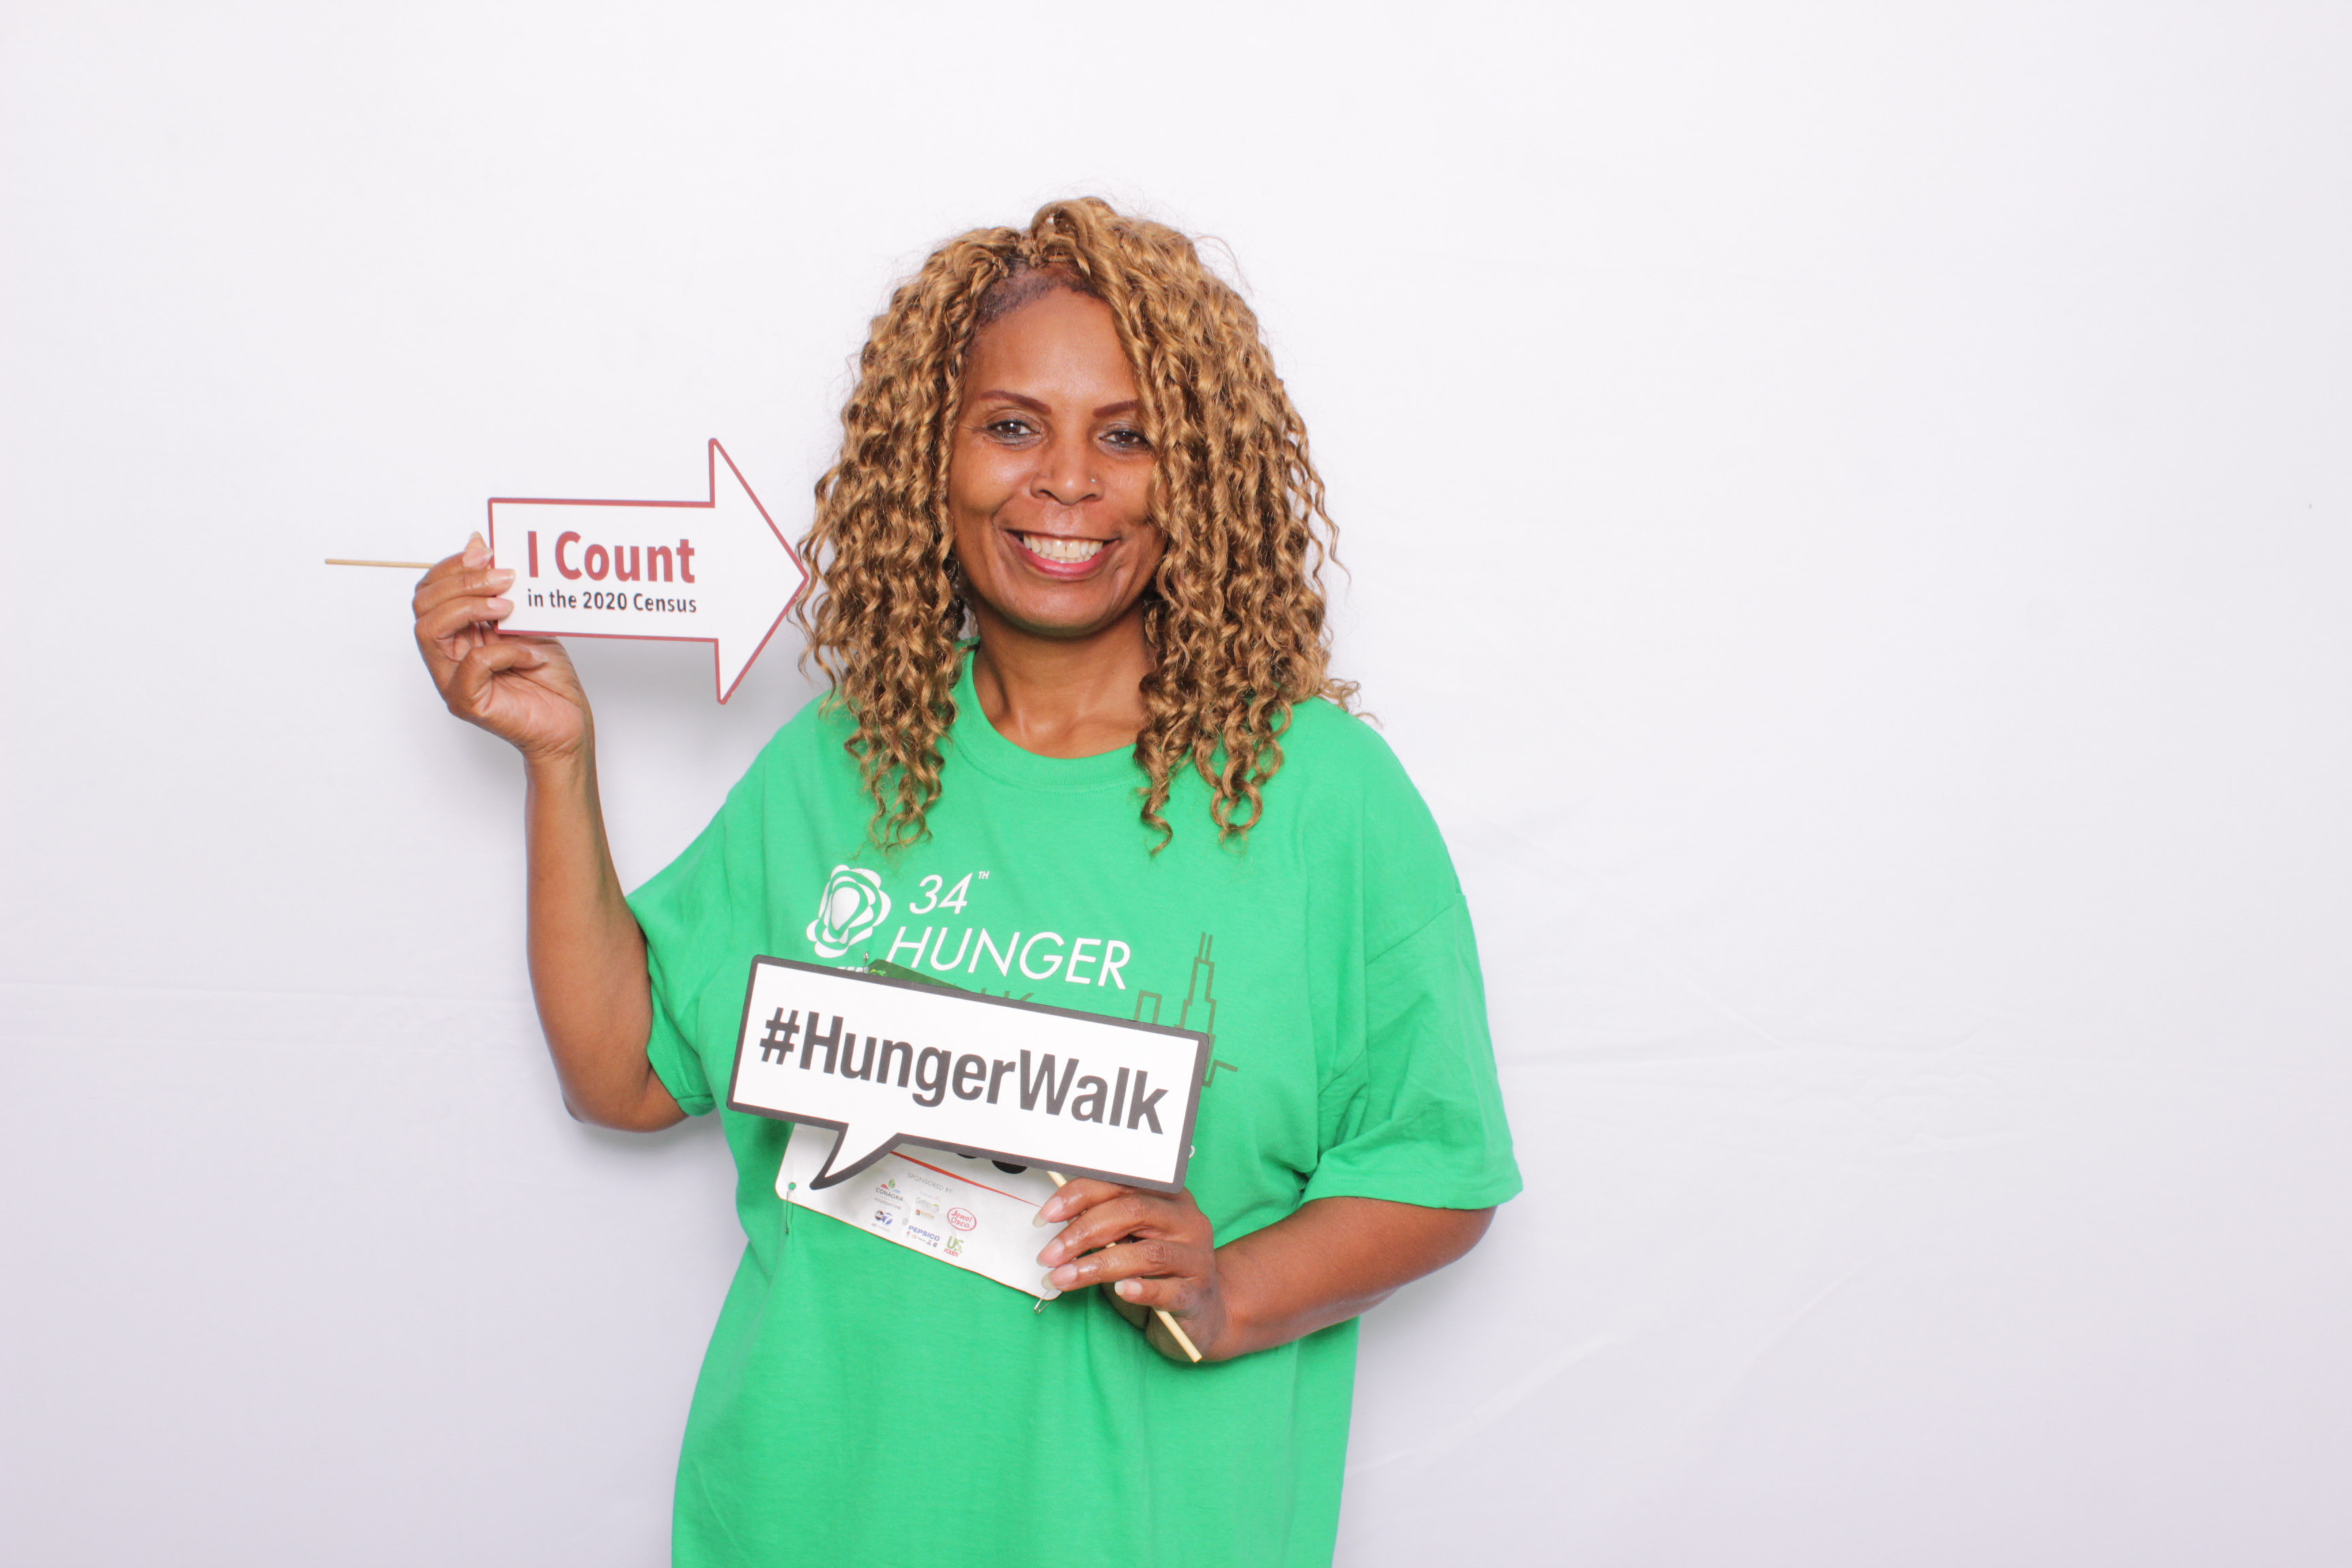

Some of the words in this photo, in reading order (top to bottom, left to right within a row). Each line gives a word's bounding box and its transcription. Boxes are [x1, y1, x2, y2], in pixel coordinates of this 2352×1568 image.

[528, 531, 539, 578] I
[555, 531, 696, 584] Count
[528, 588, 543, 607] in
[549, 589, 577, 609] the
[583, 591, 627, 611] 2020
[633, 593, 697, 612] Census
[885, 926, 1130, 990] HUNGER
[759, 1007, 1169, 1135] #HungerWalk
[907, 1173, 944, 1191] SPONSORED
[875, 1188, 904, 1202] CONAGRA
[875, 1197, 902, 1210] FOUNDATION
[951, 1210, 973, 1223] Jewel
[908, 1225, 941, 1242] PEPSICO
[943, 1247, 960, 1258] FOODS
